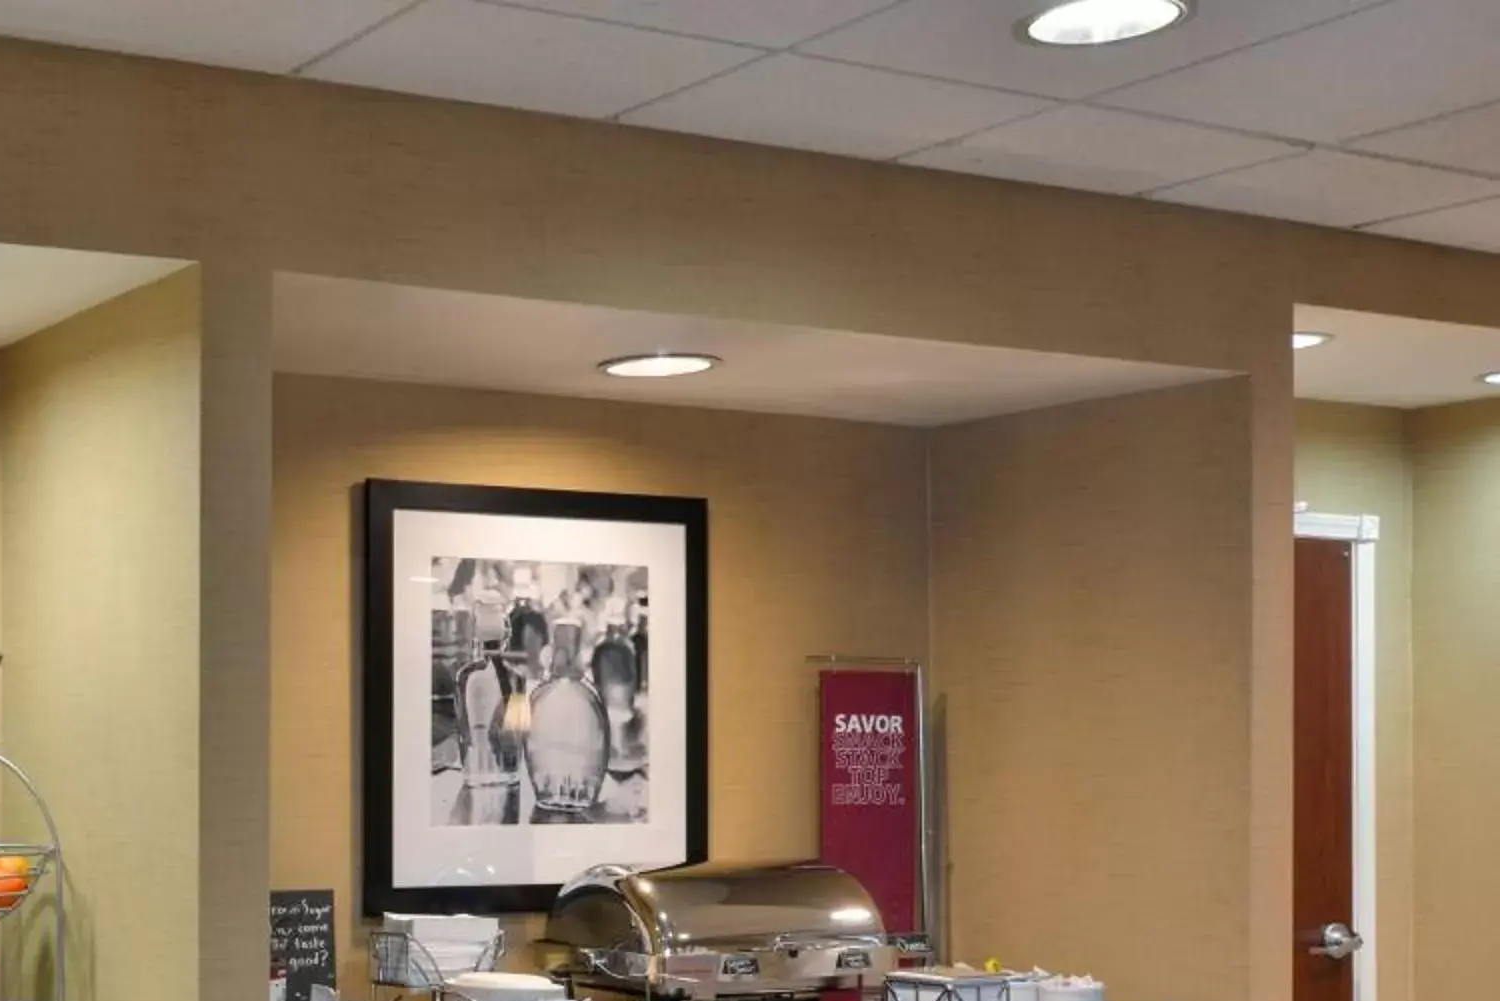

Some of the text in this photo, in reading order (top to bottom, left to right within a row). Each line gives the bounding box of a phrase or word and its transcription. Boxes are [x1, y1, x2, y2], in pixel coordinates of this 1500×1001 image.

[834, 713, 903, 734] SAVOR
[847, 766, 889, 786] TOP
[288, 947, 329, 972] good?
